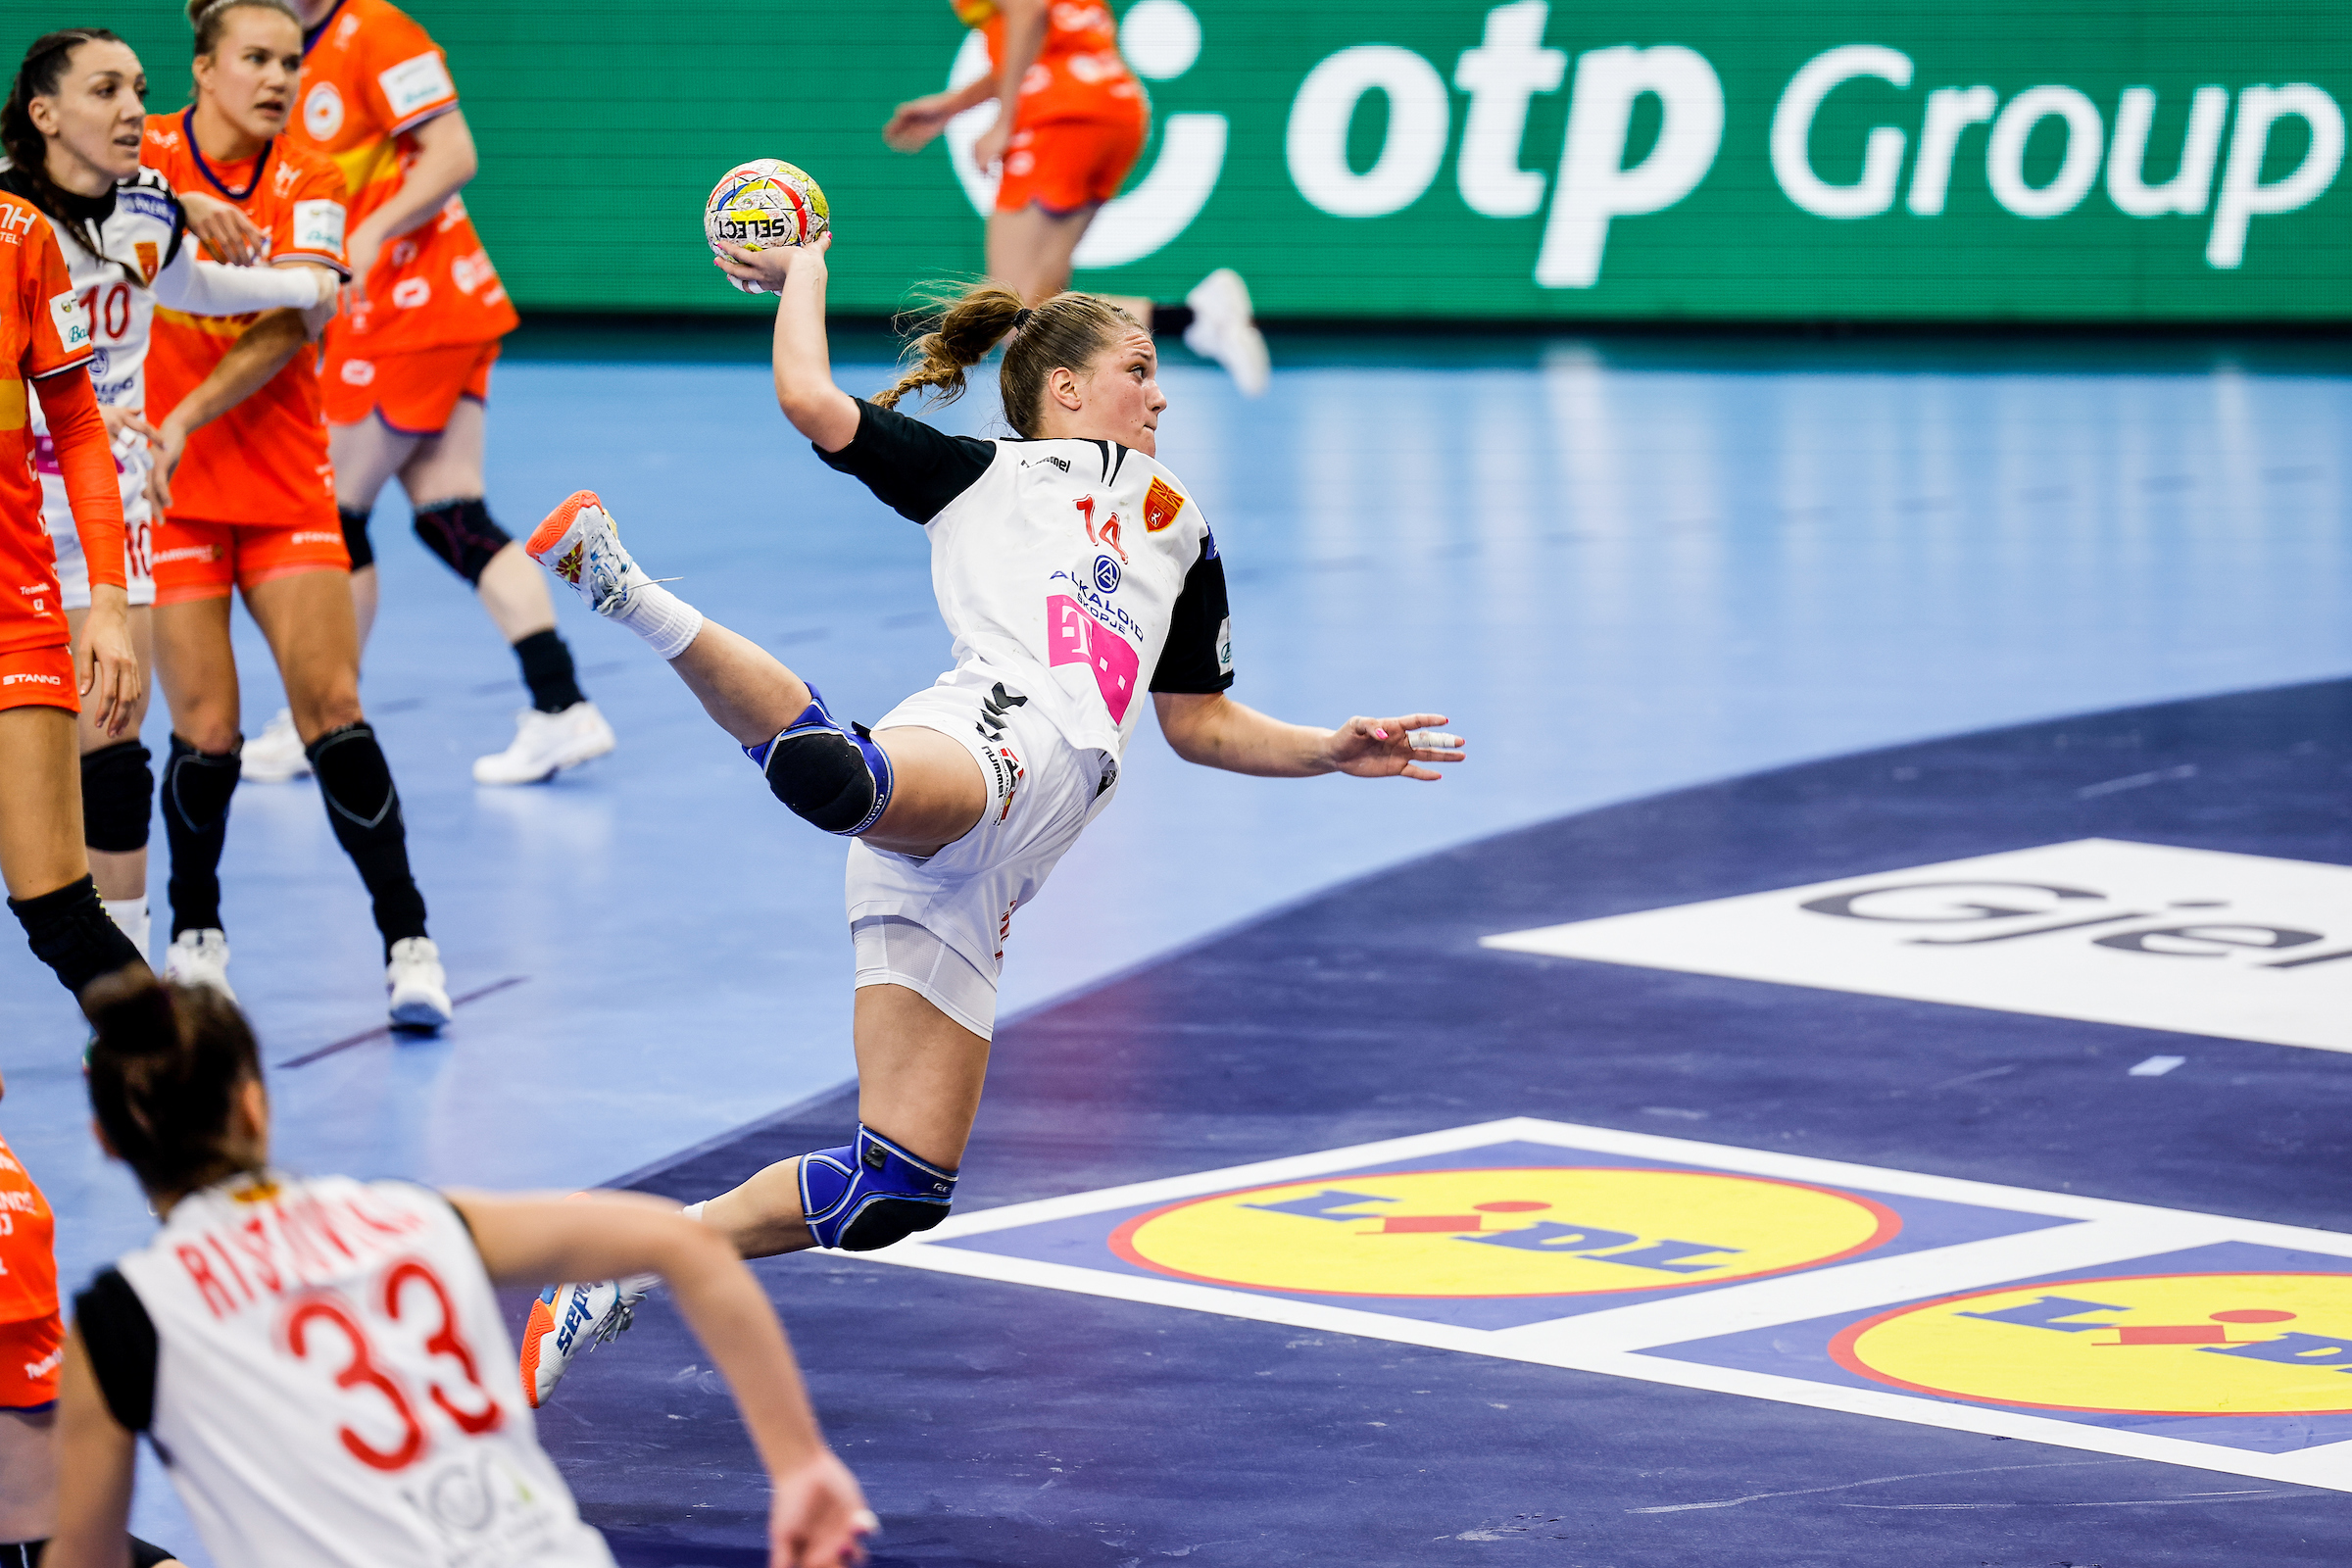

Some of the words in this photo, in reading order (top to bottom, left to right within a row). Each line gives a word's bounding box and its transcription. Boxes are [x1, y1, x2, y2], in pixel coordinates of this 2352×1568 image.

[1286, 0, 1725, 288] otp
[1770, 43, 2345, 269] Group
[718, 218, 785, 240] SELECT
[78, 281, 130, 341] 10
[1071, 493, 1129, 564] 14
[1049, 569, 1144, 643] ALKALOID
[1076, 591, 1127, 636] SKOPJE
[284, 1257, 504, 1475] 33
